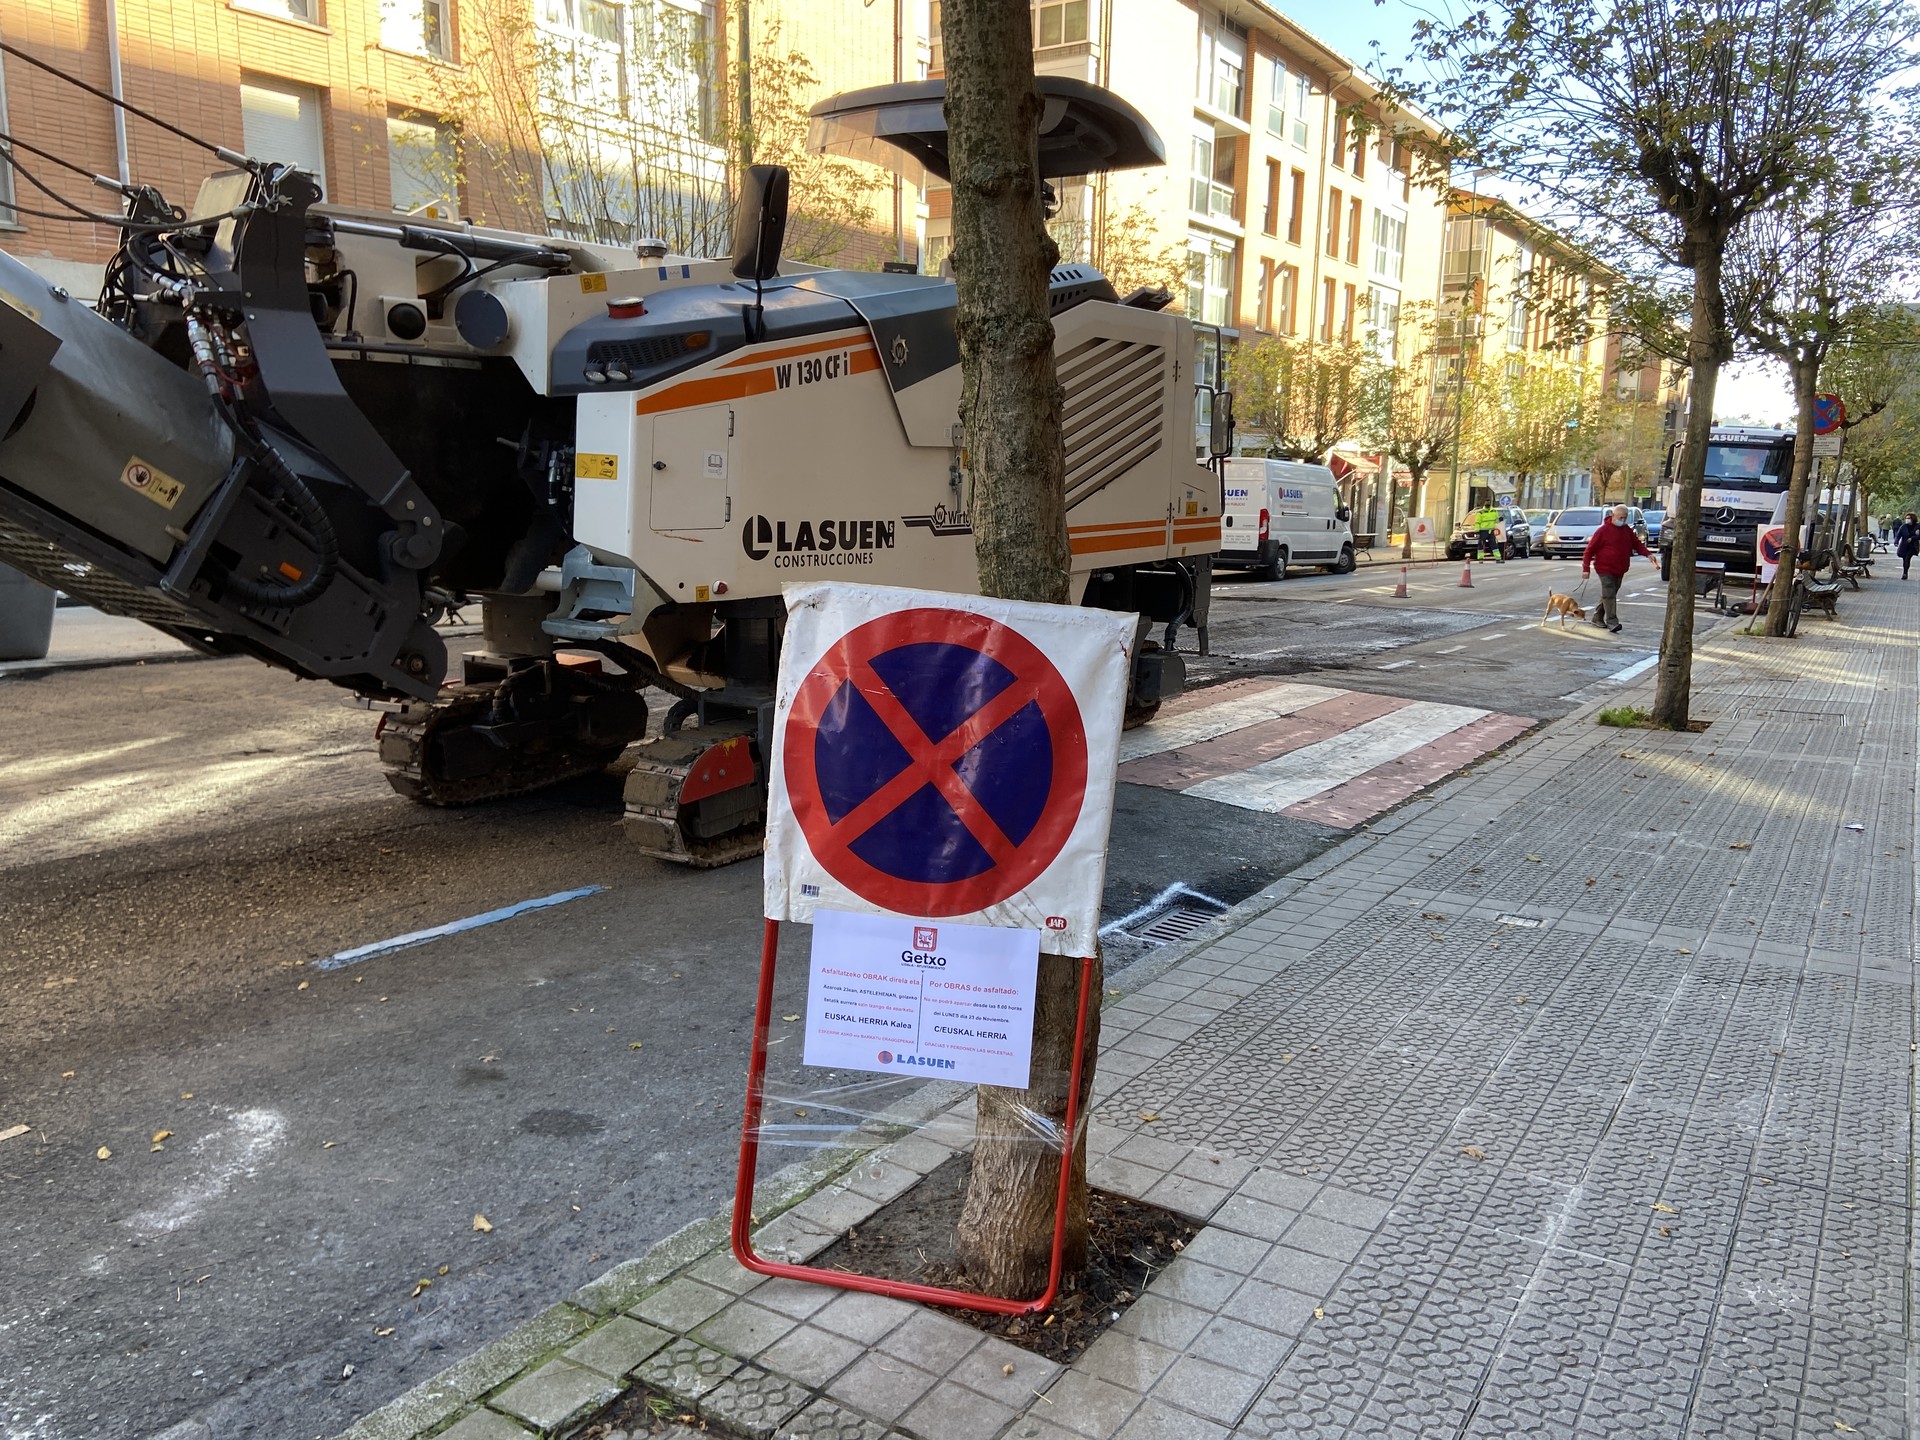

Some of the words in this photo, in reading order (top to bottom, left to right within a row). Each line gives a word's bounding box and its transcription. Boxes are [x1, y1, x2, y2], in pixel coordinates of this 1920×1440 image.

[776, 363, 792, 389] W
[797, 358, 822, 385] 130
[825, 354, 840, 379] CF
[777, 520, 894, 552] LASUEN
[774, 552, 873, 568] CONSTRUCCIONES
[1048, 918, 1064, 928] JAR
[901, 950, 947, 967] Getxo
[862, 973, 888, 982] OBRAK
[859, 989, 897, 998] ASTELEHENAN,
[929, 980, 942, 988] Por
[943, 982, 971, 991] OBRAS
[983, 987, 1019, 995] asfaltado:
[824, 1012, 857, 1022] EUSKAL
[858, 1016, 889, 1026] HERRIA
[890, 1020, 912, 1029] Kalea
[934, 1025, 974, 1036] C/EUSKAL
[976, 1030, 1007, 1040] HERRIA
[950, 1044, 976, 1052] PERDONEN
[897, 1054, 956, 1069] LASUEN
